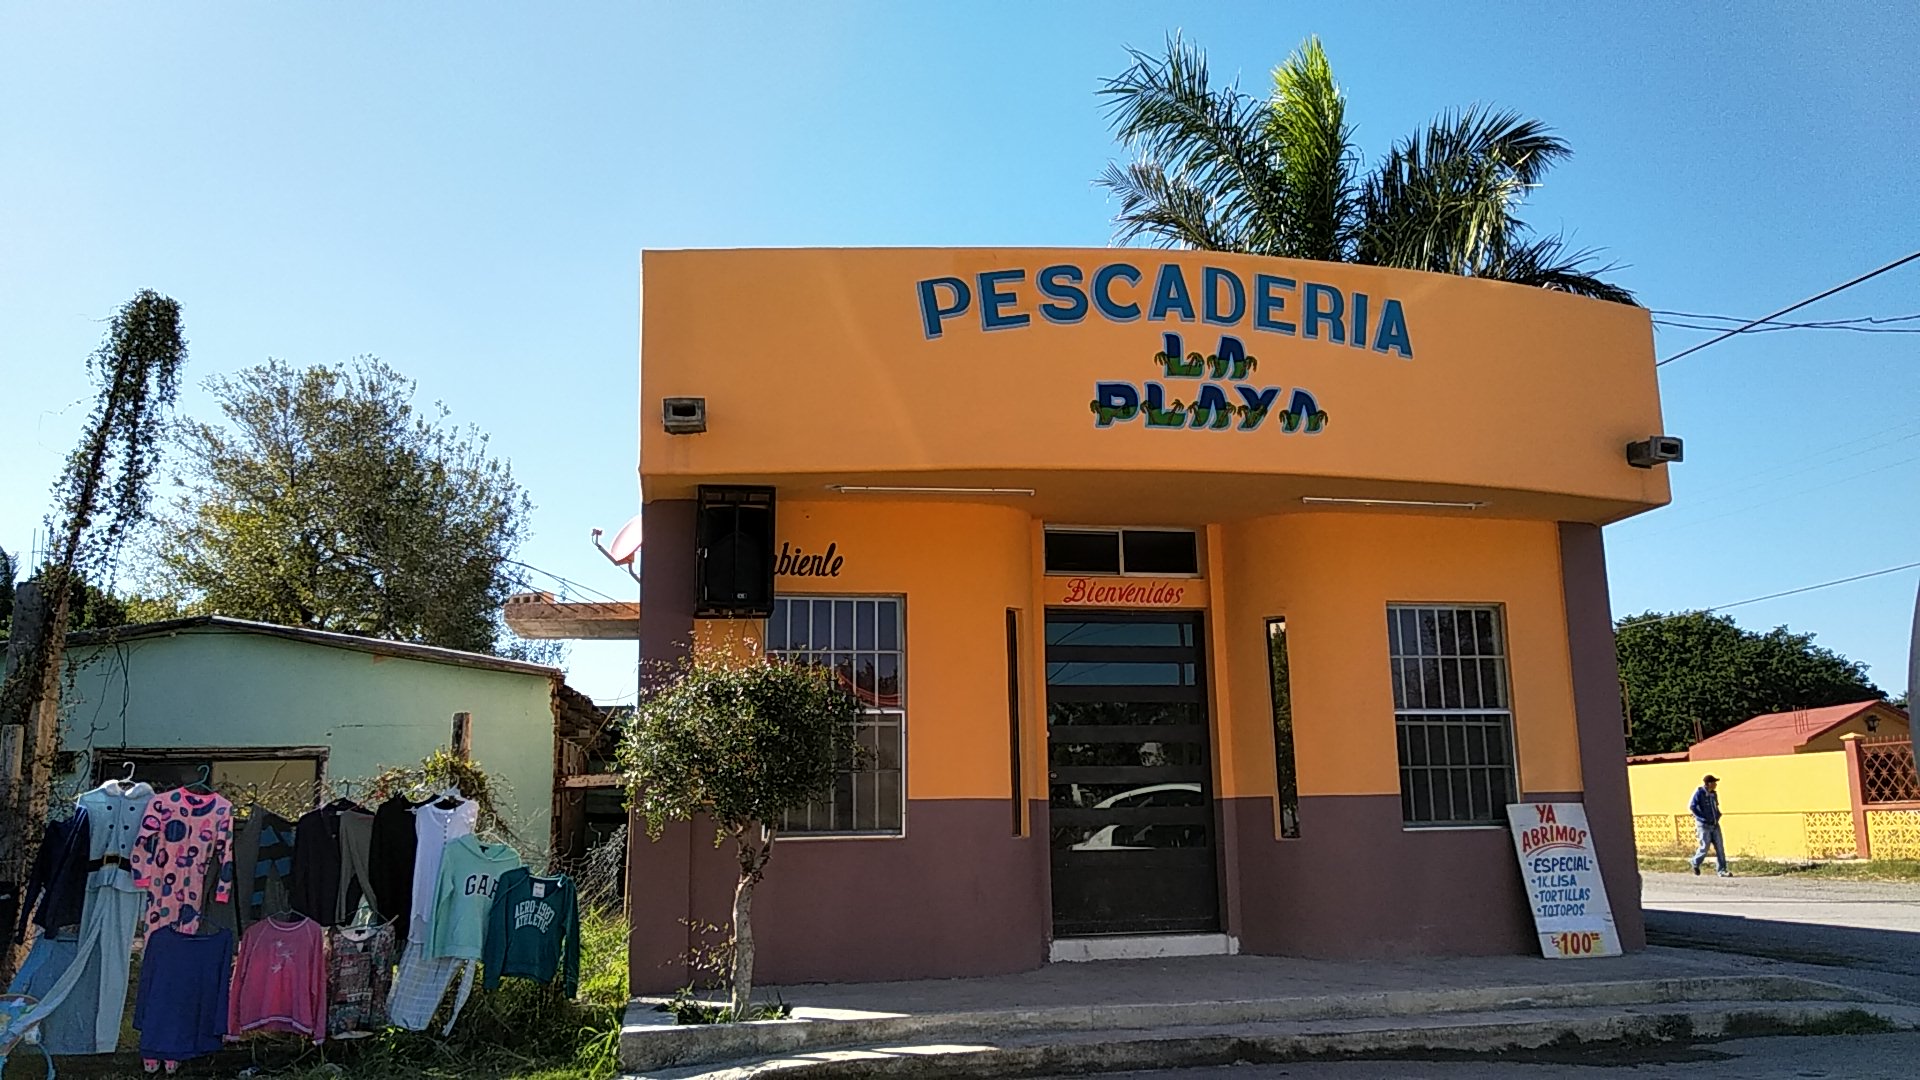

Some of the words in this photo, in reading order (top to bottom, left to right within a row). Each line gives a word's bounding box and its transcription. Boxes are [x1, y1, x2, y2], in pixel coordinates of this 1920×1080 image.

[917, 263, 1414, 359] PESCADERIA
[1155, 331, 1257, 381] LA
[1091, 381, 1328, 434] PLAYA
[1063, 577, 1184, 604] Bienvenidos
[1535, 804, 1557, 825] YA
[1522, 825, 1587, 853] ABRIMOS
